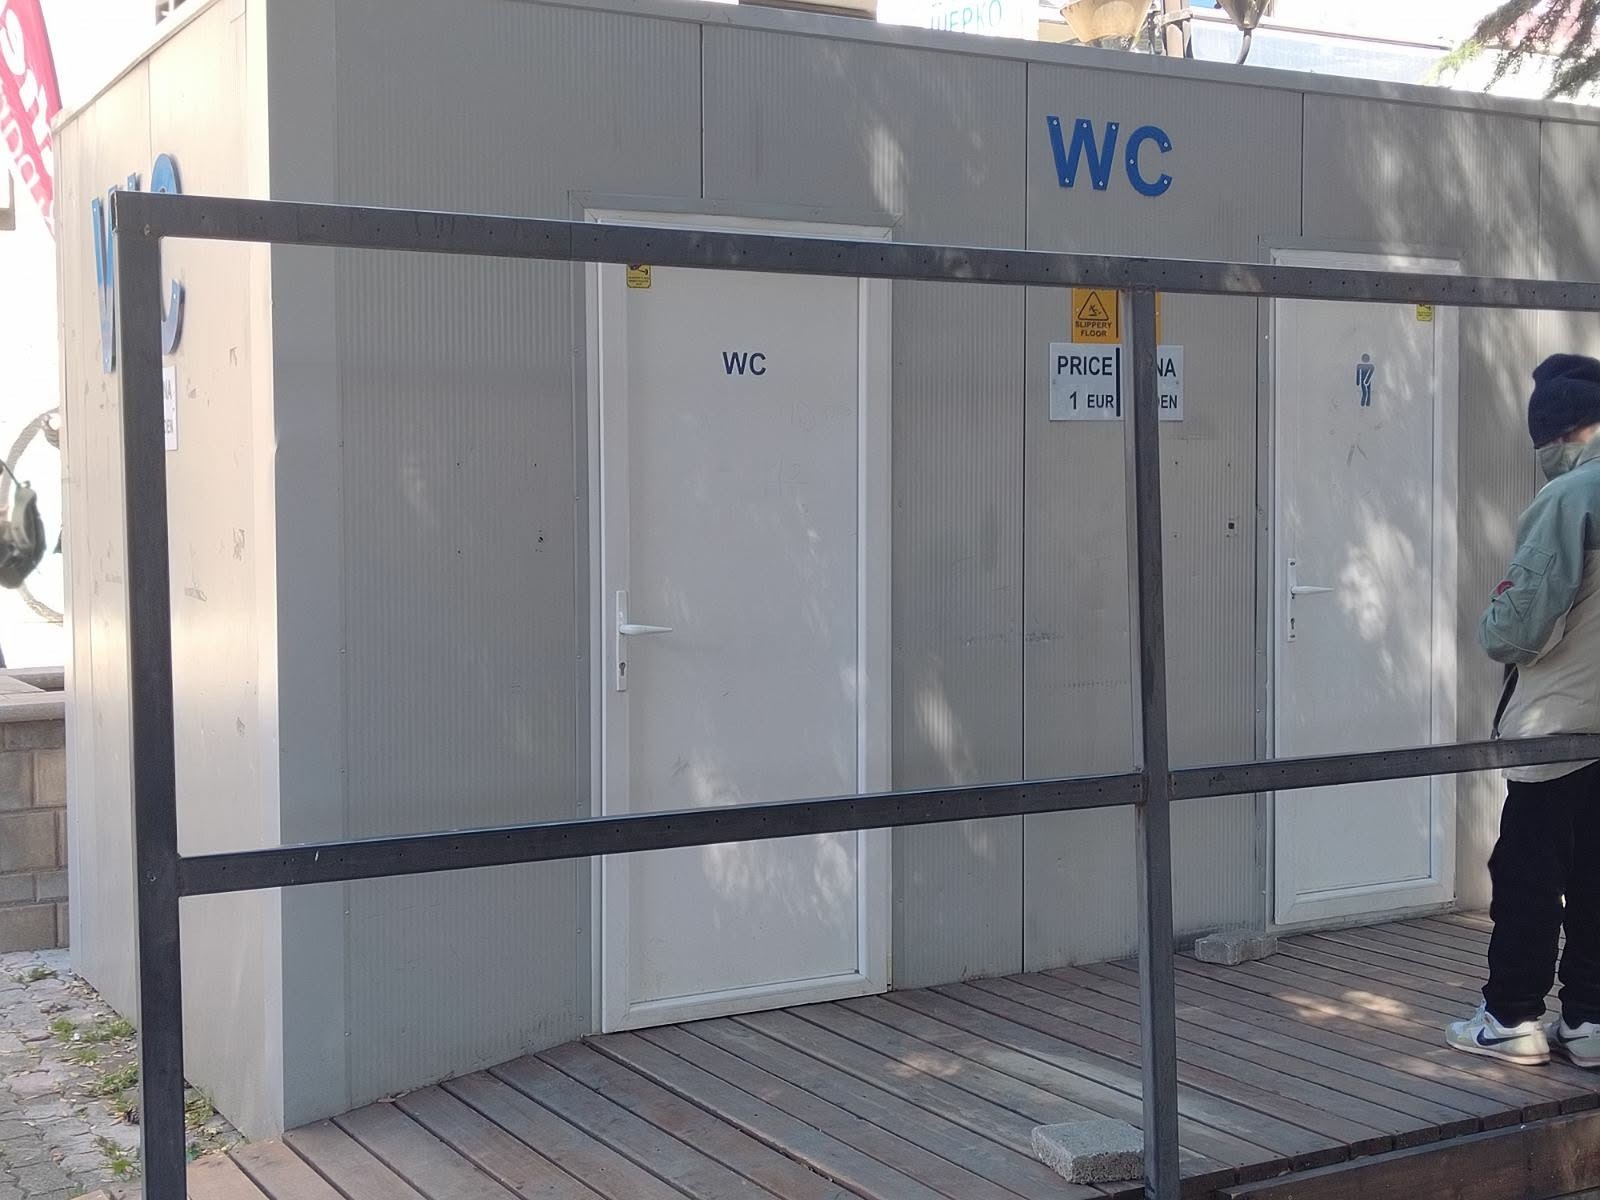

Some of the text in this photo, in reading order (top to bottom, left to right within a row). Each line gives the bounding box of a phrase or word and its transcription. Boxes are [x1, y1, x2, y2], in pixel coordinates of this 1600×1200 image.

[1046, 115, 1173, 197] WC
[1075, 321, 1112, 329] SLIPPERY
[722, 352, 767, 376] WC
[1057, 356, 1113, 376] PRICE
[1157, 358, 1177, 377] NA
[1069, 391, 1114, 409] 1 EUR
[1158, 395, 1178, 409] EN
